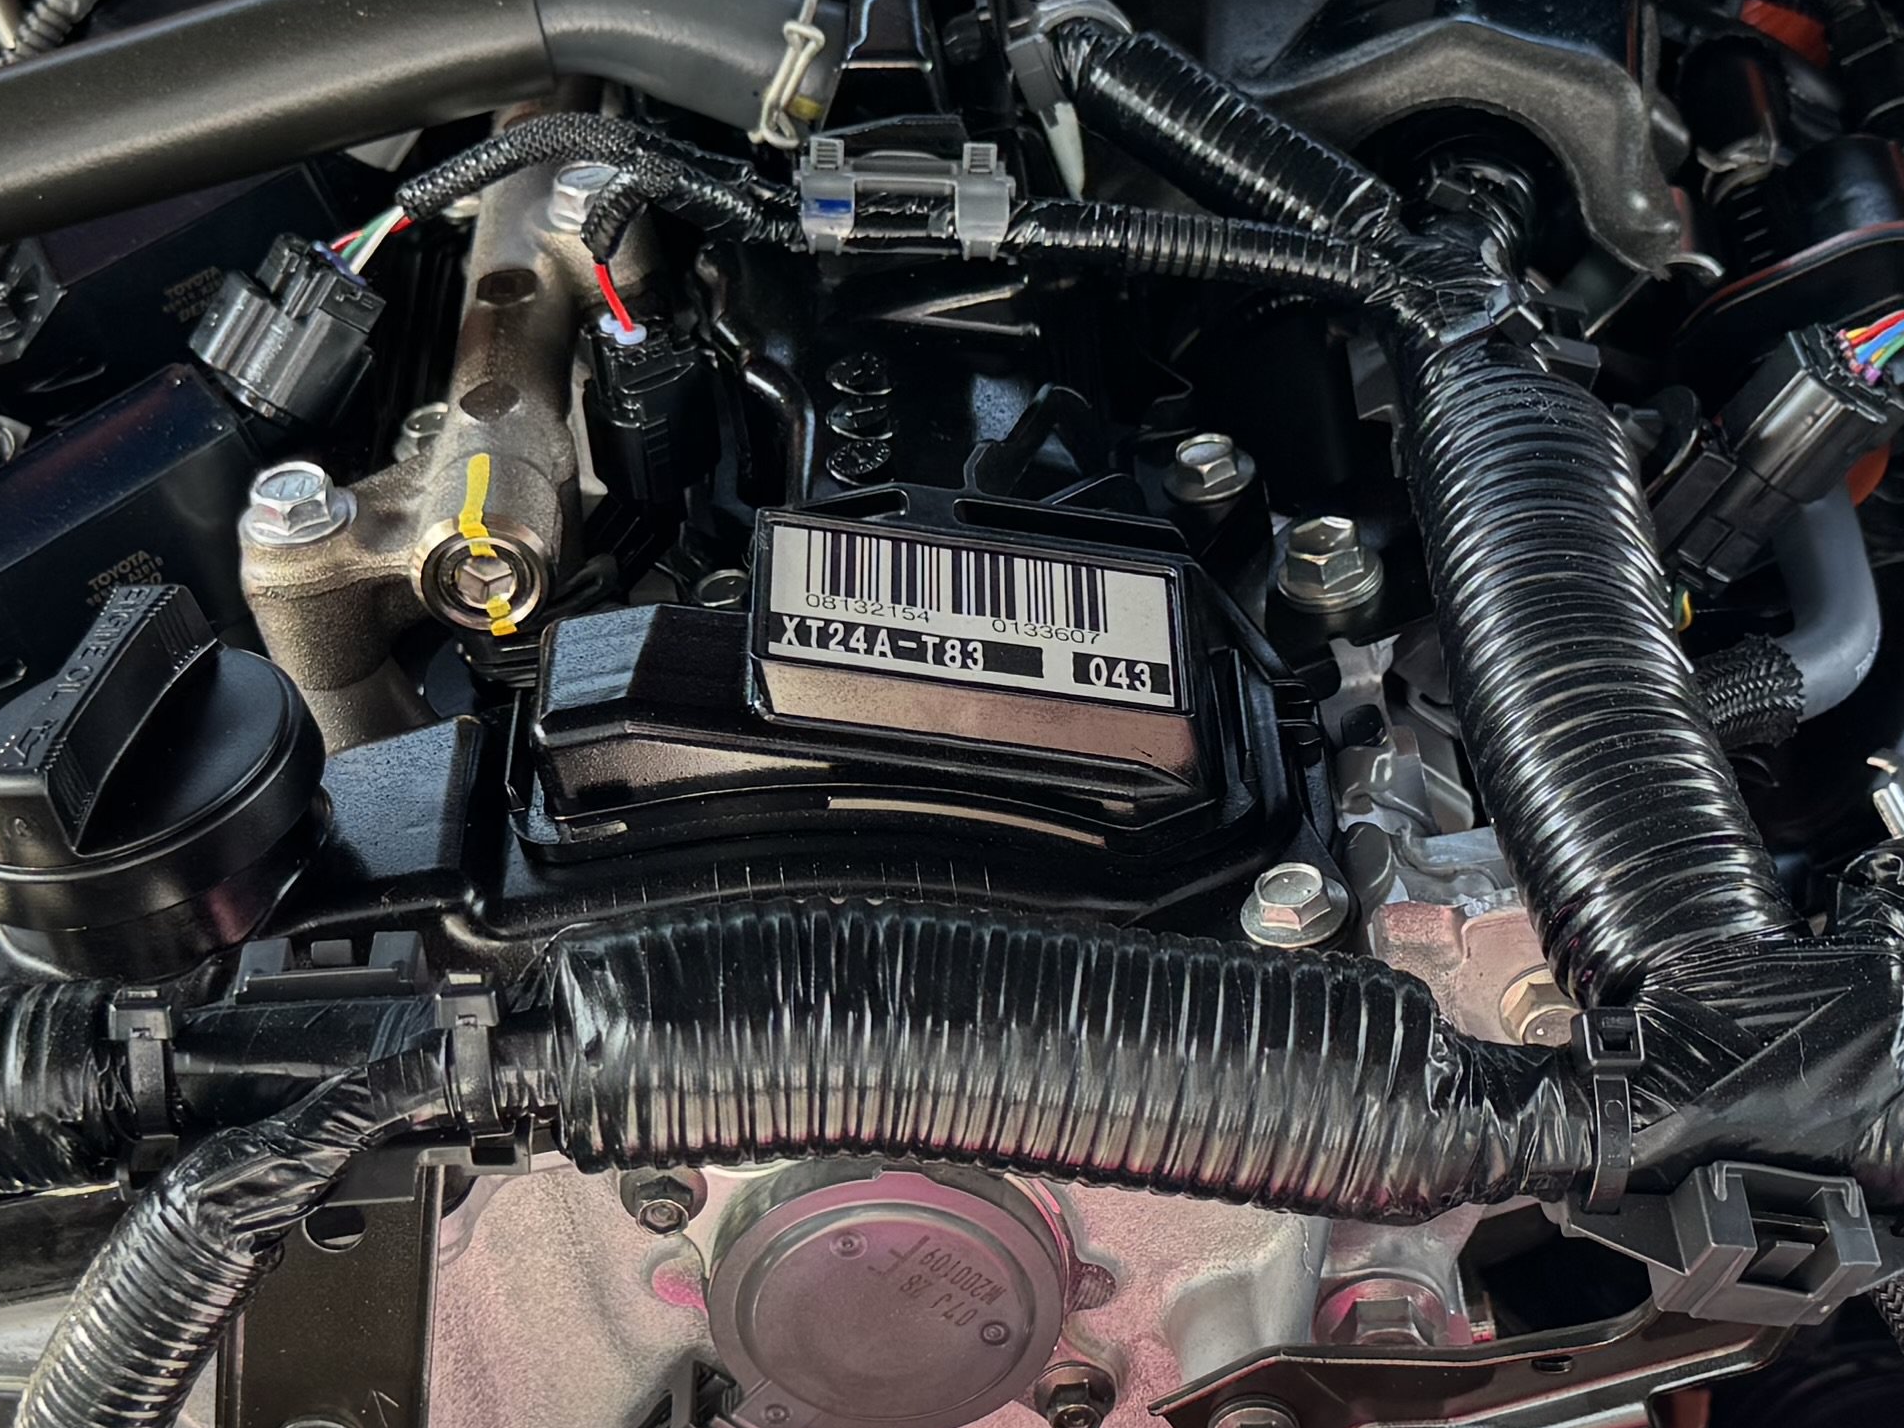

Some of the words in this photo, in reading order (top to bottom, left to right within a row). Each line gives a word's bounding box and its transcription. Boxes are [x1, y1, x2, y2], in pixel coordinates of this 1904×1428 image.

[164, 266, 223, 297] TOYOTA
[89, 550, 151, 590] TOYOTA
[78, 586, 152, 660] ENGINE
[805, 592, 930, 624] 08132154
[991, 618, 1100, 646] 0133607
[780, 614, 985, 673] XT24A-T83
[1088, 657, 1153, 693] 043
[54, 664, 95, 701] OIL
